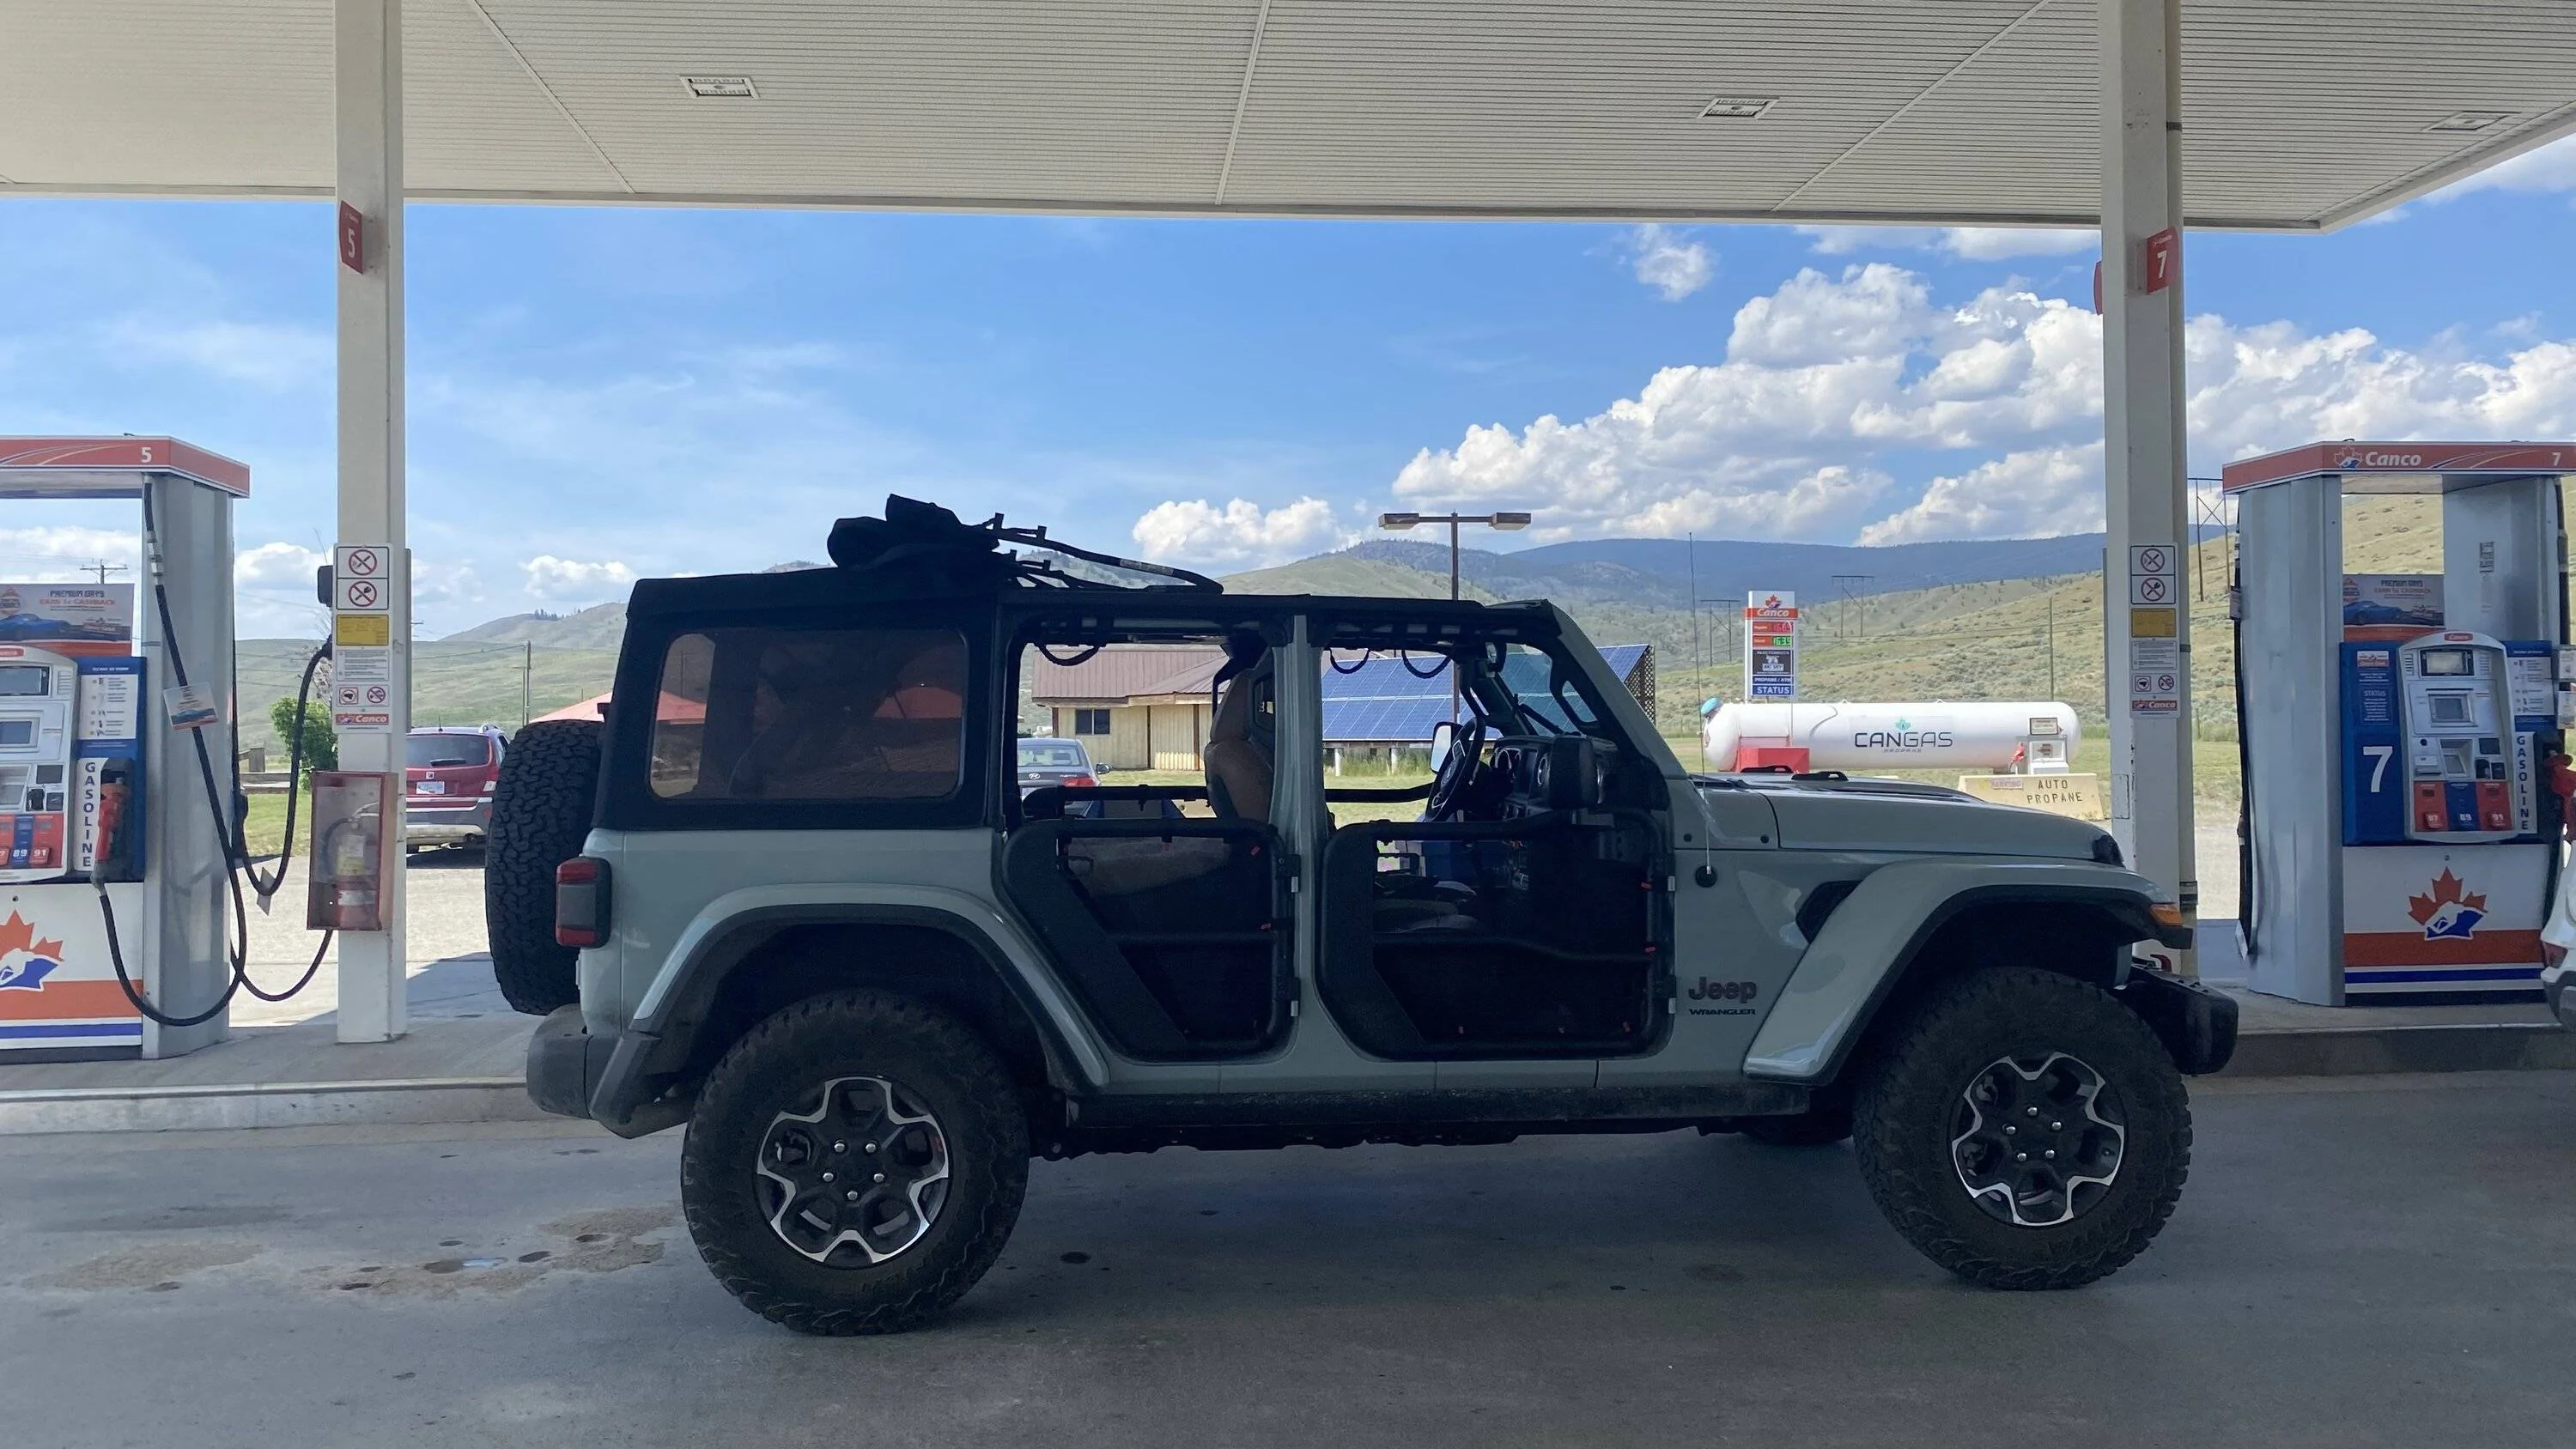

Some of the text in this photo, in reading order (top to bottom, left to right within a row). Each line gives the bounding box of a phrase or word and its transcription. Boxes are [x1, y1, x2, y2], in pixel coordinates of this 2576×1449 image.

[348, 227, 355, 258] 5
[2157, 250, 2167, 279] 7
[141, 446, 152, 463] 5
[2366, 452, 2421, 466] Canco
[2552, 452, 2561, 466] 7
[1757, 686, 1789, 694] STATUS
[2148, 700, 2176, 709] Canco
[355, 714, 387, 723] Canco
[1855, 731, 1953, 748] CANGAS
[2363, 746, 2393, 792] 7
[2038, 779, 2069, 790] AUTO
[2517, 735, 2529, 830] GASOLINE
[2027, 791, 2083, 803] PROPANE
[82, 761, 96, 867] GASOLINE
[13, 849, 27, 858] 89
[1688, 977, 1758, 1003] Jeep
